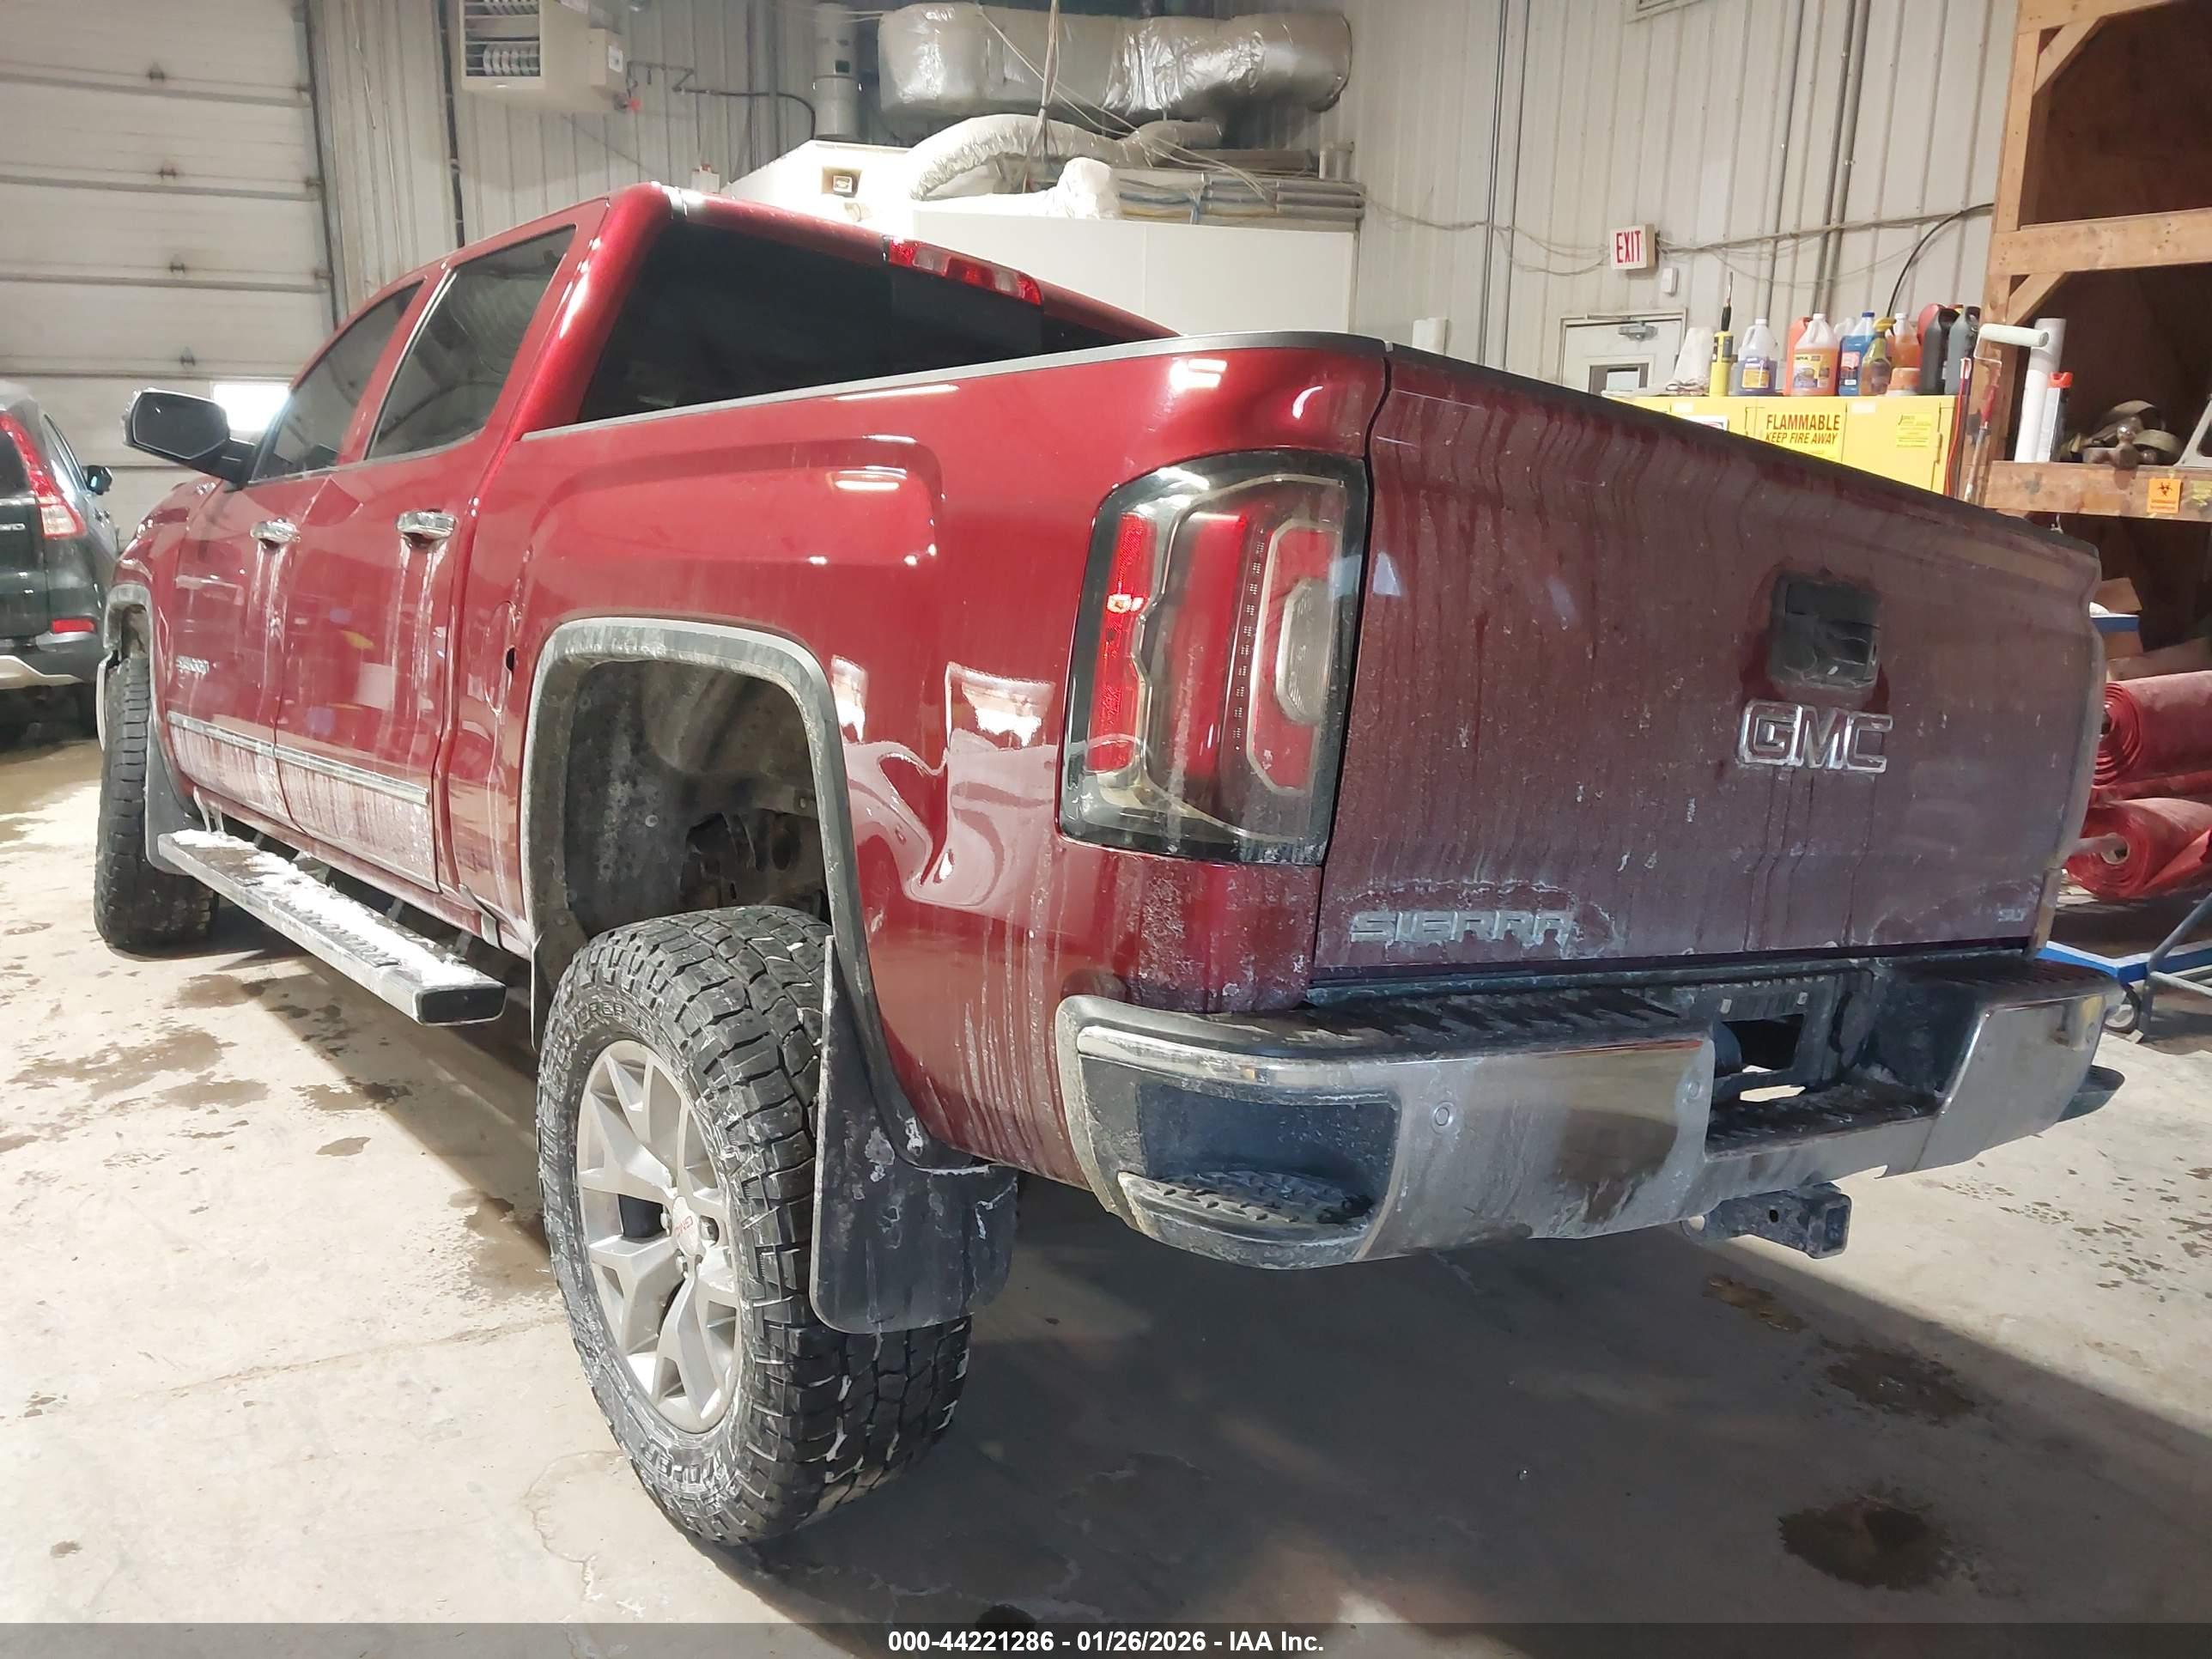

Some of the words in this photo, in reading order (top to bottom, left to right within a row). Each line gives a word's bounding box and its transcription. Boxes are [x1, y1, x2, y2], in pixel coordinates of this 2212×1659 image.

[1616, 230, 1641, 264] EXIT
[1765, 432, 1788, 443] KEEP
[1790, 432, 1810, 444] FIRE
[1811, 432, 1838, 445] AWAY
[1766, 414, 1841, 431] FLAMMABLE
[1738, 700, 1893, 773] GMC
[1350, 909, 1575, 945] SIERRA
